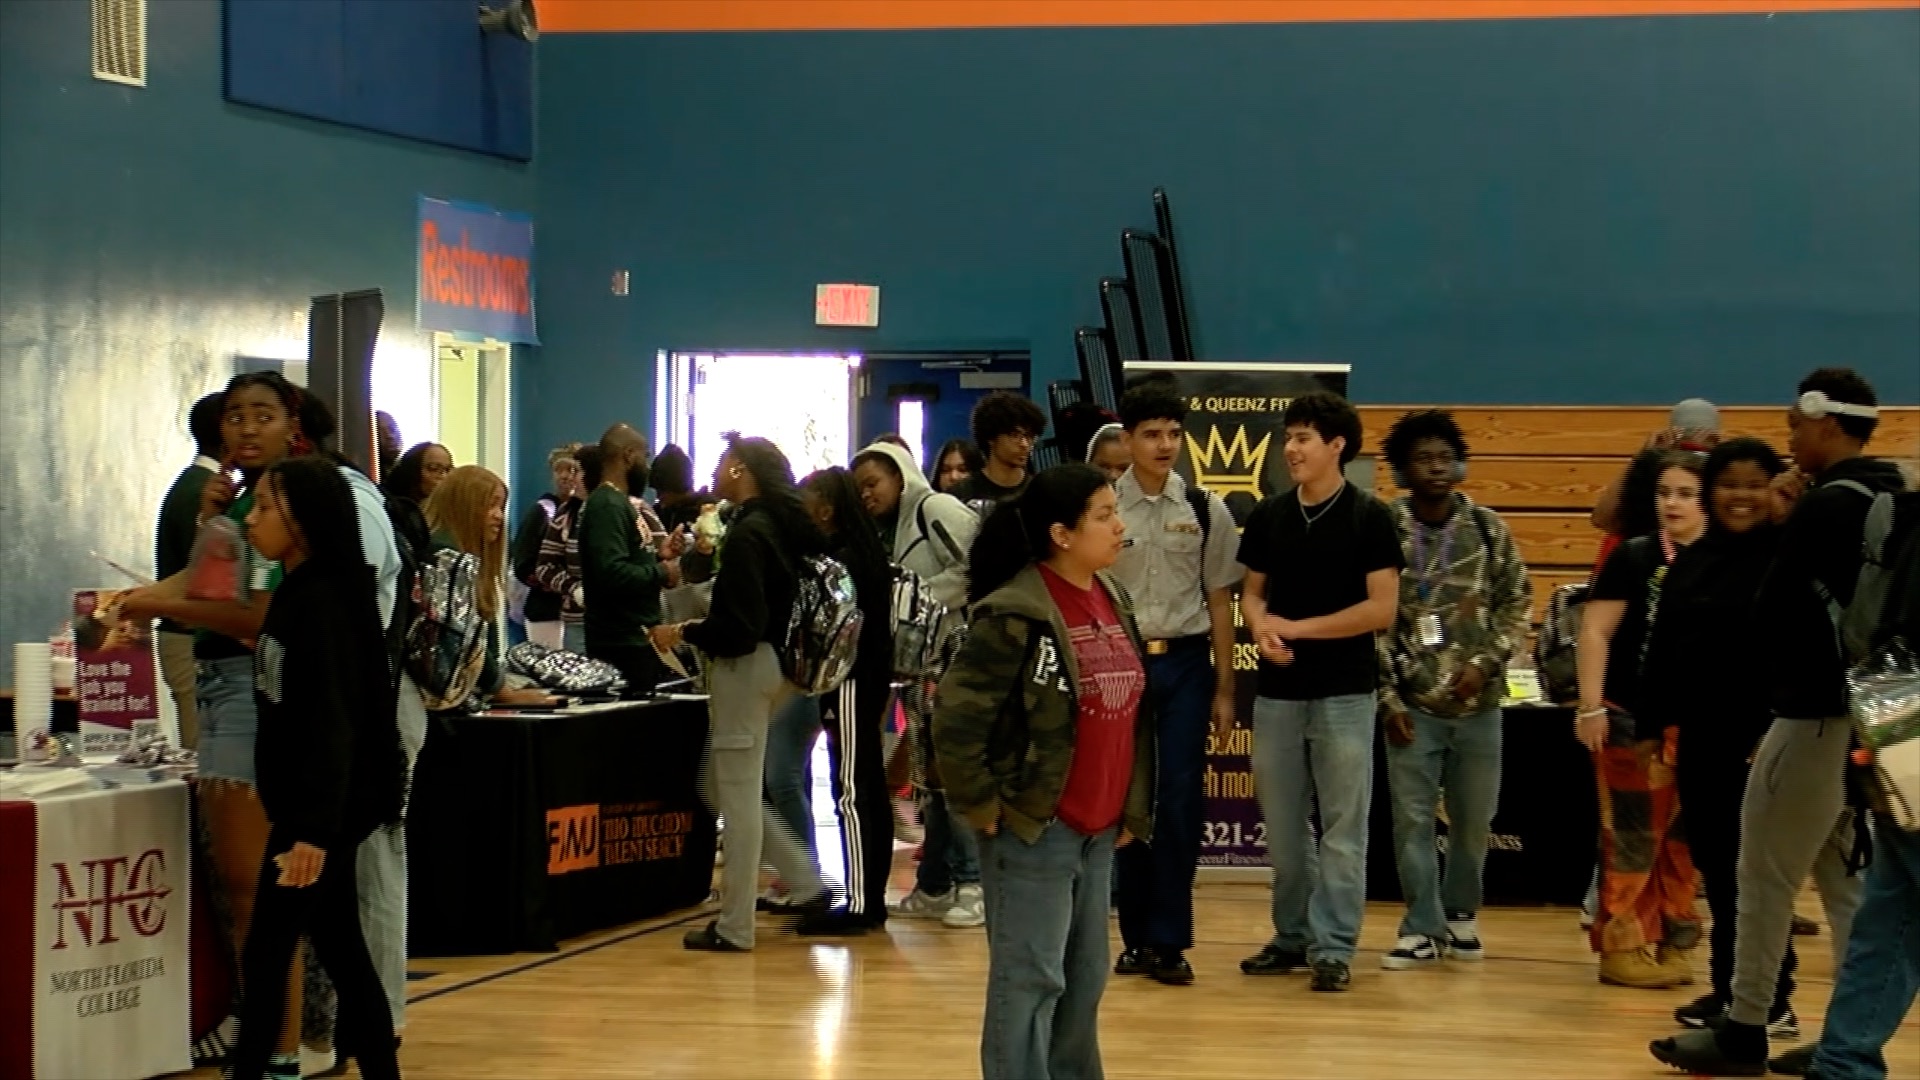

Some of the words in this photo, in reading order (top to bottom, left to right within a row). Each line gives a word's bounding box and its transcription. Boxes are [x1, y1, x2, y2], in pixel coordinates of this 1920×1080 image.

[422, 218, 529, 316] Restrooms
[827, 287, 871, 322] EXIT
[1205, 397, 1267, 413] QUEENZ
[80, 660, 110, 677] Love
[111, 660, 132, 677] the
[81, 678, 102, 699] job
[104, 681, 127, 697] you
[82, 694, 127, 712] trained
[128, 694, 151, 712] for!
[1200, 821, 1268, 848] 321-2
[50, 849, 167, 950] NFC
[50, 967, 103, 996] NORTH
[105, 956, 165, 987] FLORIDA
[77, 985, 142, 1019] COLLEGE
